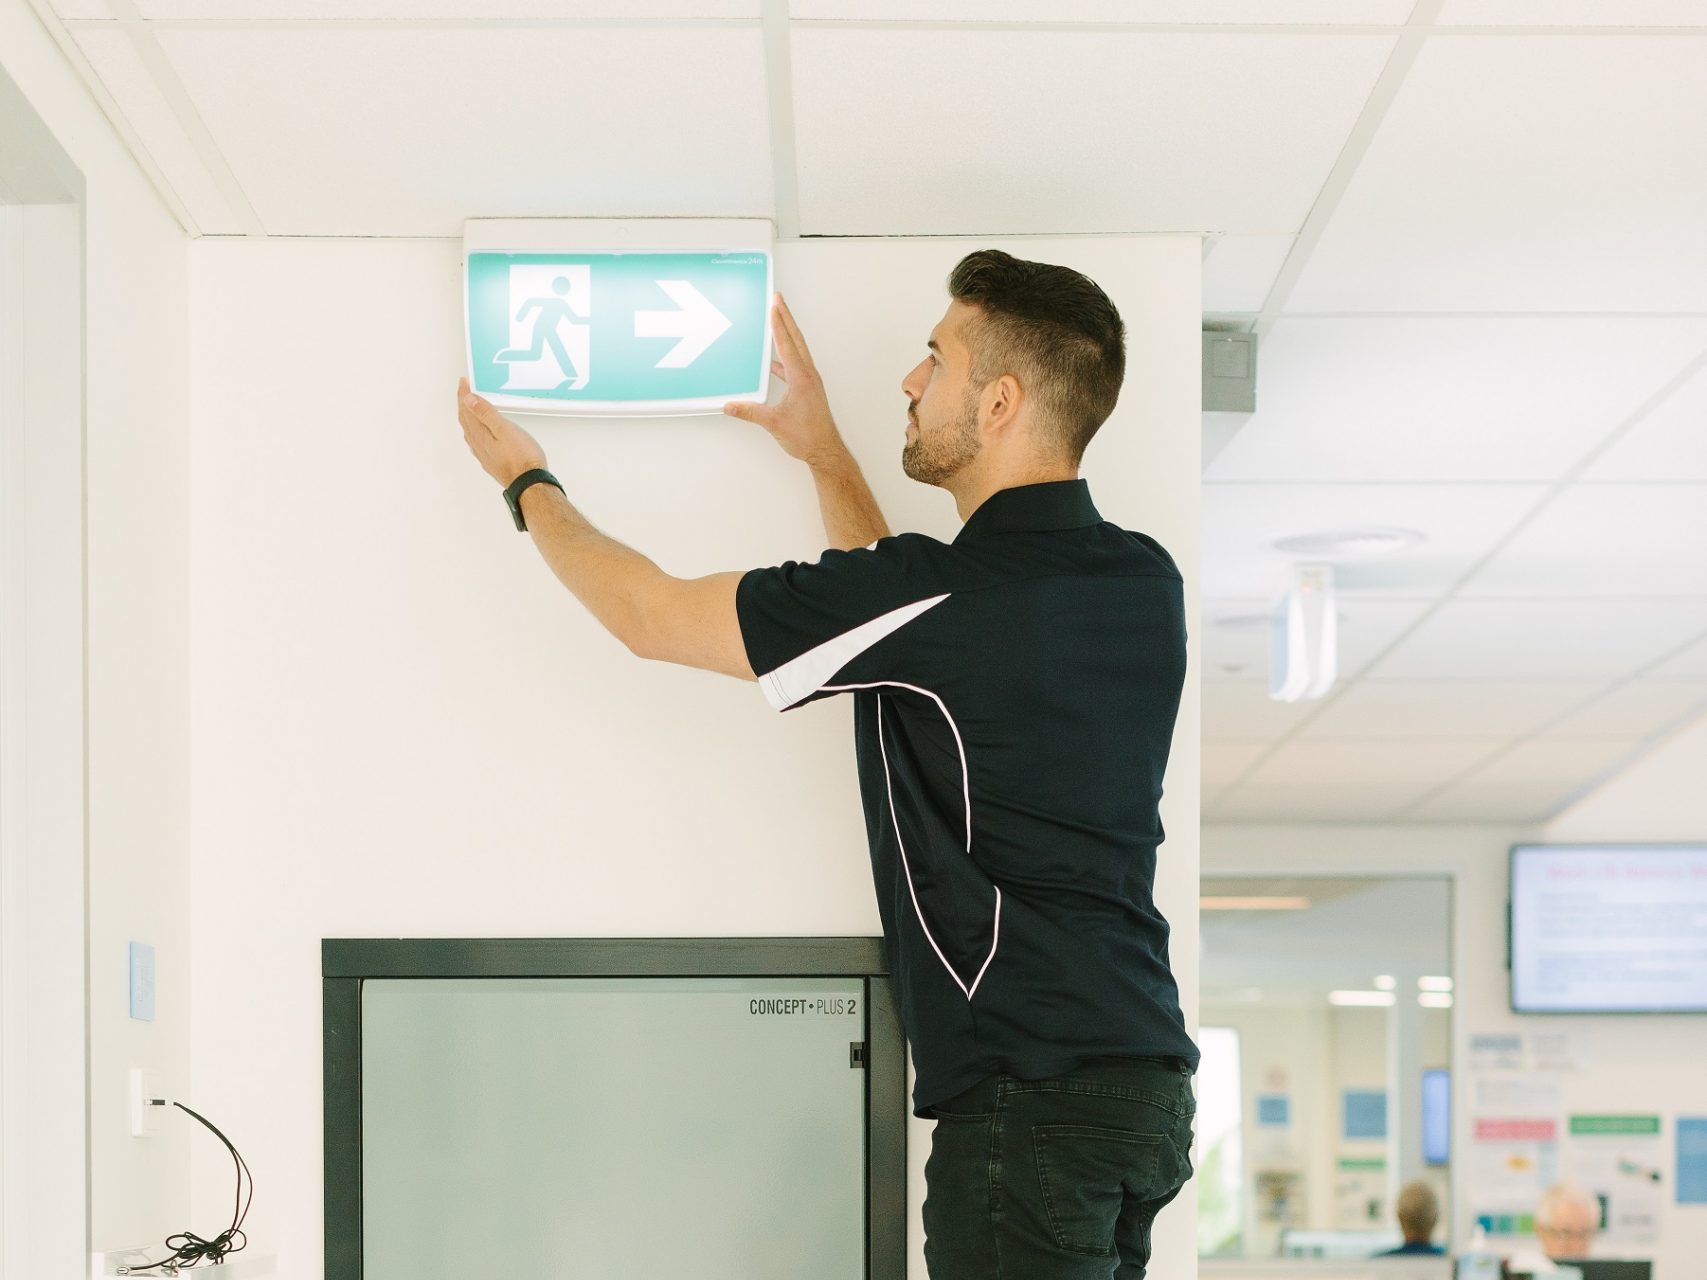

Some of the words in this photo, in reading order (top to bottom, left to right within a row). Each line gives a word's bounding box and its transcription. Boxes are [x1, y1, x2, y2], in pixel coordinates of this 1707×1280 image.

[749, 999, 807, 1015] CONCEPT
[817, 999, 844, 1015] PLUS
[847, 999, 856, 1015] 2
